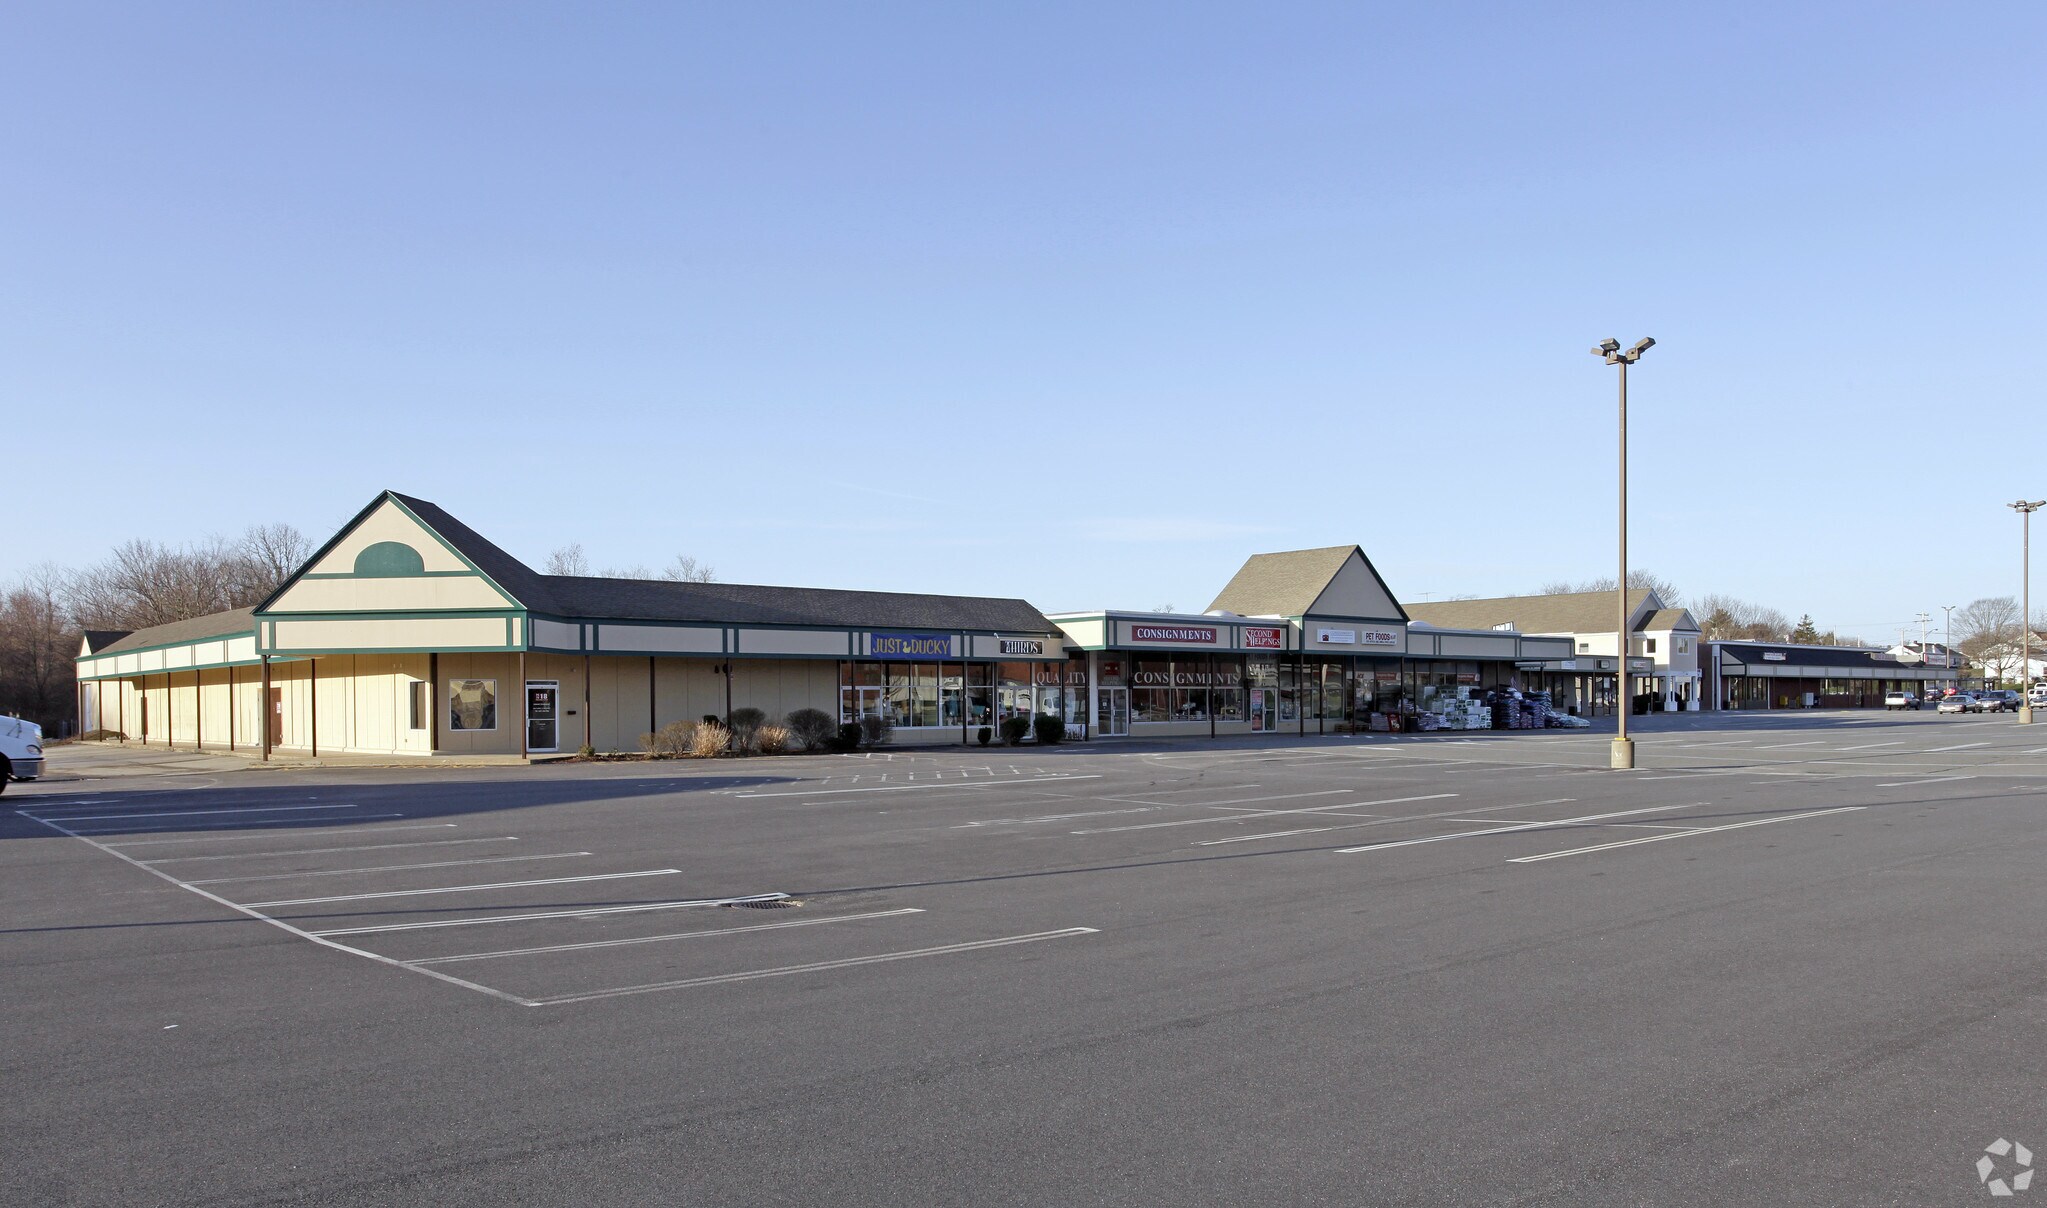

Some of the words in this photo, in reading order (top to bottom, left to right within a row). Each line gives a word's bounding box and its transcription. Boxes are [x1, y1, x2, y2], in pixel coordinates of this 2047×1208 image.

[1137, 627, 1211, 641] CONSIGNMENTS
[1246, 629, 1272, 641] SECOND
[1365, 632, 1374, 641] PET
[1376, 632, 1391, 641] FOODS
[872, 637, 902, 653] JUST
[911, 639, 950, 655] DUCKY
[1036, 671, 1086, 686] QUAITY
